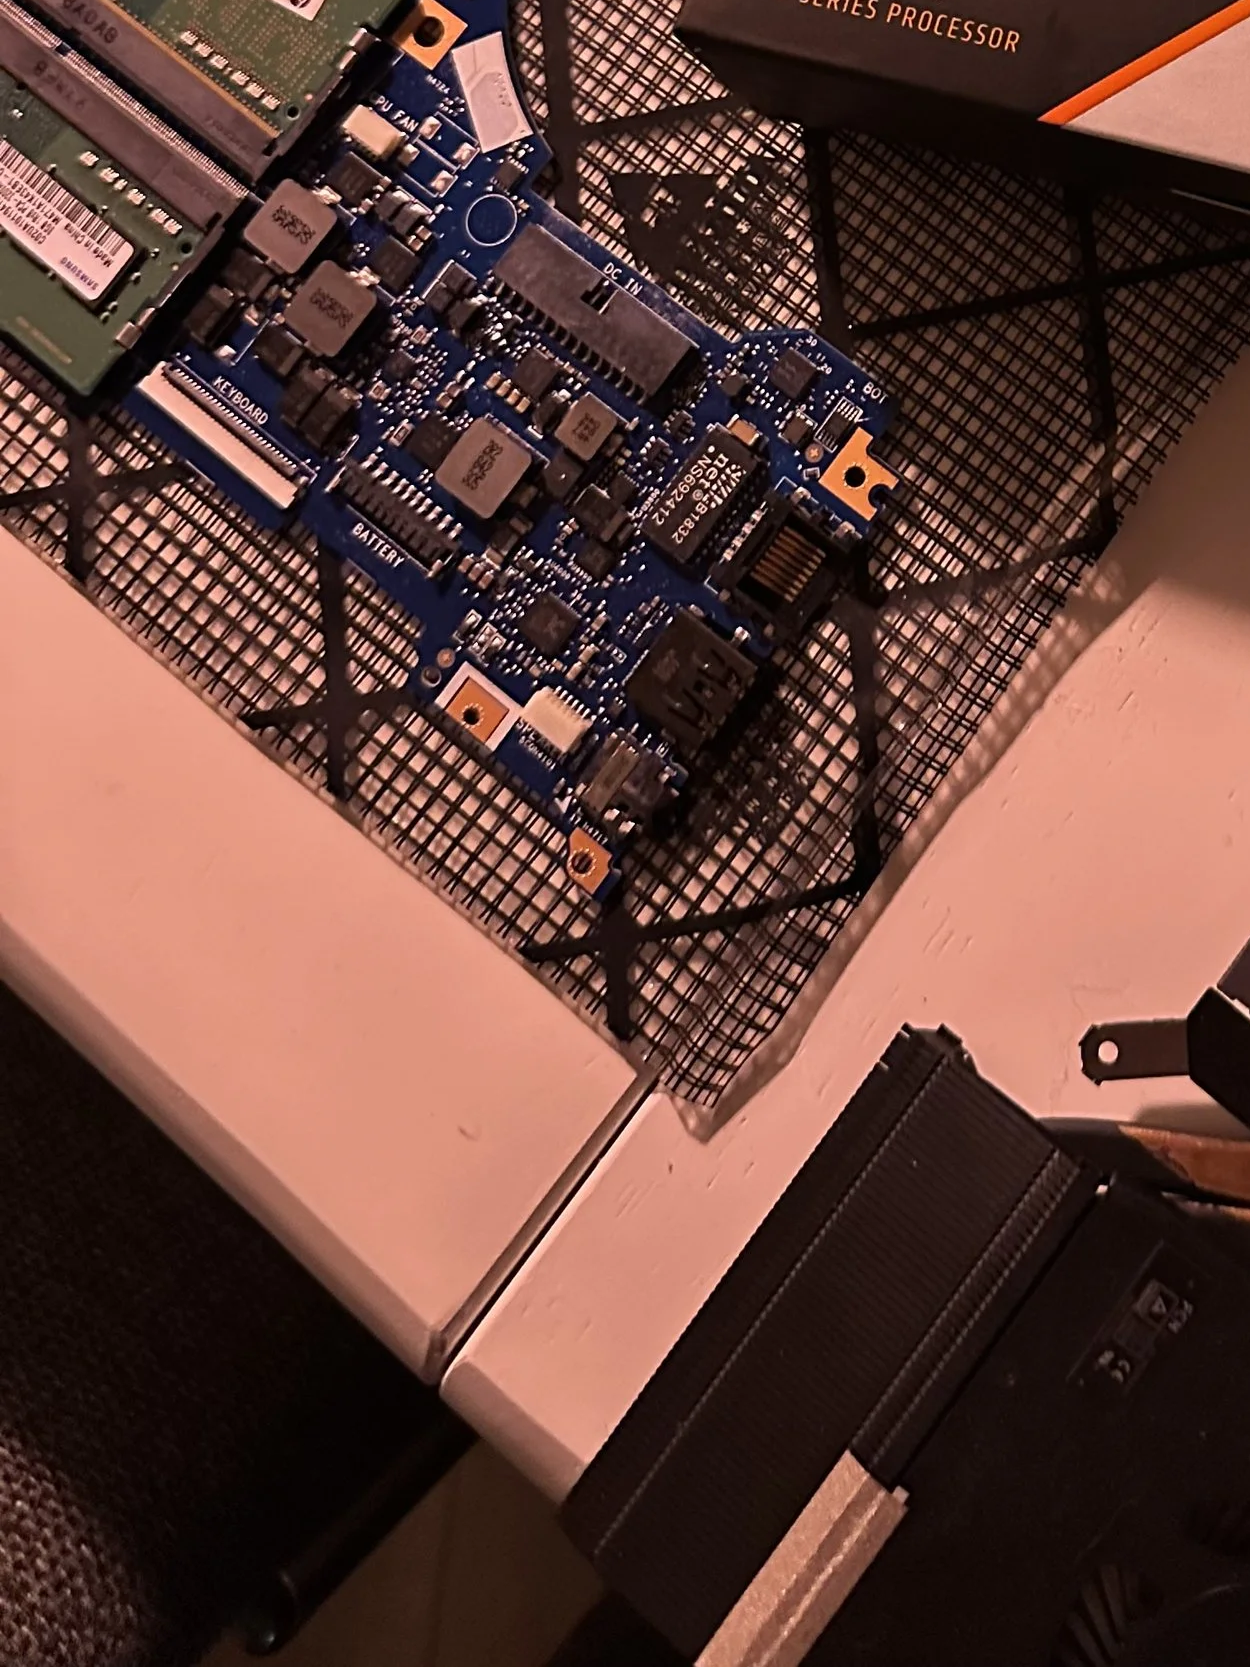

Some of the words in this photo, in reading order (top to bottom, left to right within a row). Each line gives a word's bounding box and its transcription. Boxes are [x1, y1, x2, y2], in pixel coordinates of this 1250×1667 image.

[886, 2, 1020, 53] PROCESSOR
[391, 109, 419, 133] FAN
[63, 222, 84, 244] China
[84, 242, 93, 252] in
[60, 256, 99, 291] SAMSUNG
[92, 247, 115, 268] Made
[603, 262, 623, 281] DC
[624, 277, 643, 296] IN
[213, 375, 269, 426] KEYBOARD
[863, 382, 889, 405] BOT
[651, 454, 712, 526] NS692412
[671, 502, 710, 545] B1832
[352, 522, 405, 568] BATTERY
